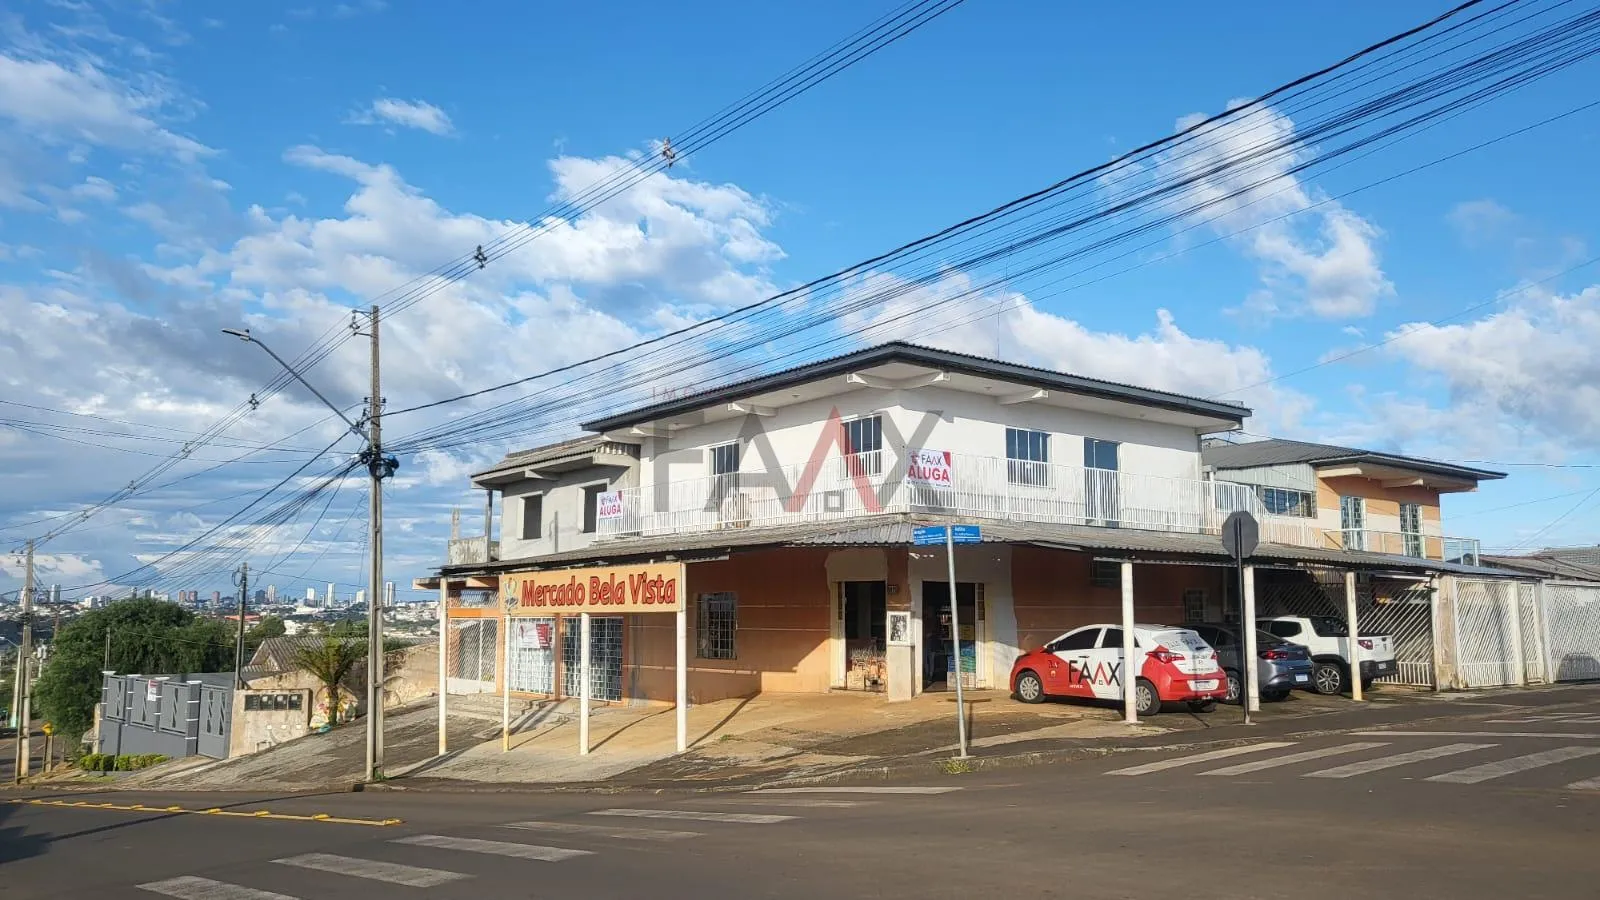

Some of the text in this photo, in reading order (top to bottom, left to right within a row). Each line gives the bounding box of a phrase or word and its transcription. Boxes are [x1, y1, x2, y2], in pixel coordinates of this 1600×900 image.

[908, 464, 950, 482] ALUGA
[600, 504, 621, 516] ALUGA
[521, 572, 676, 607] Mercado Bela Vista
